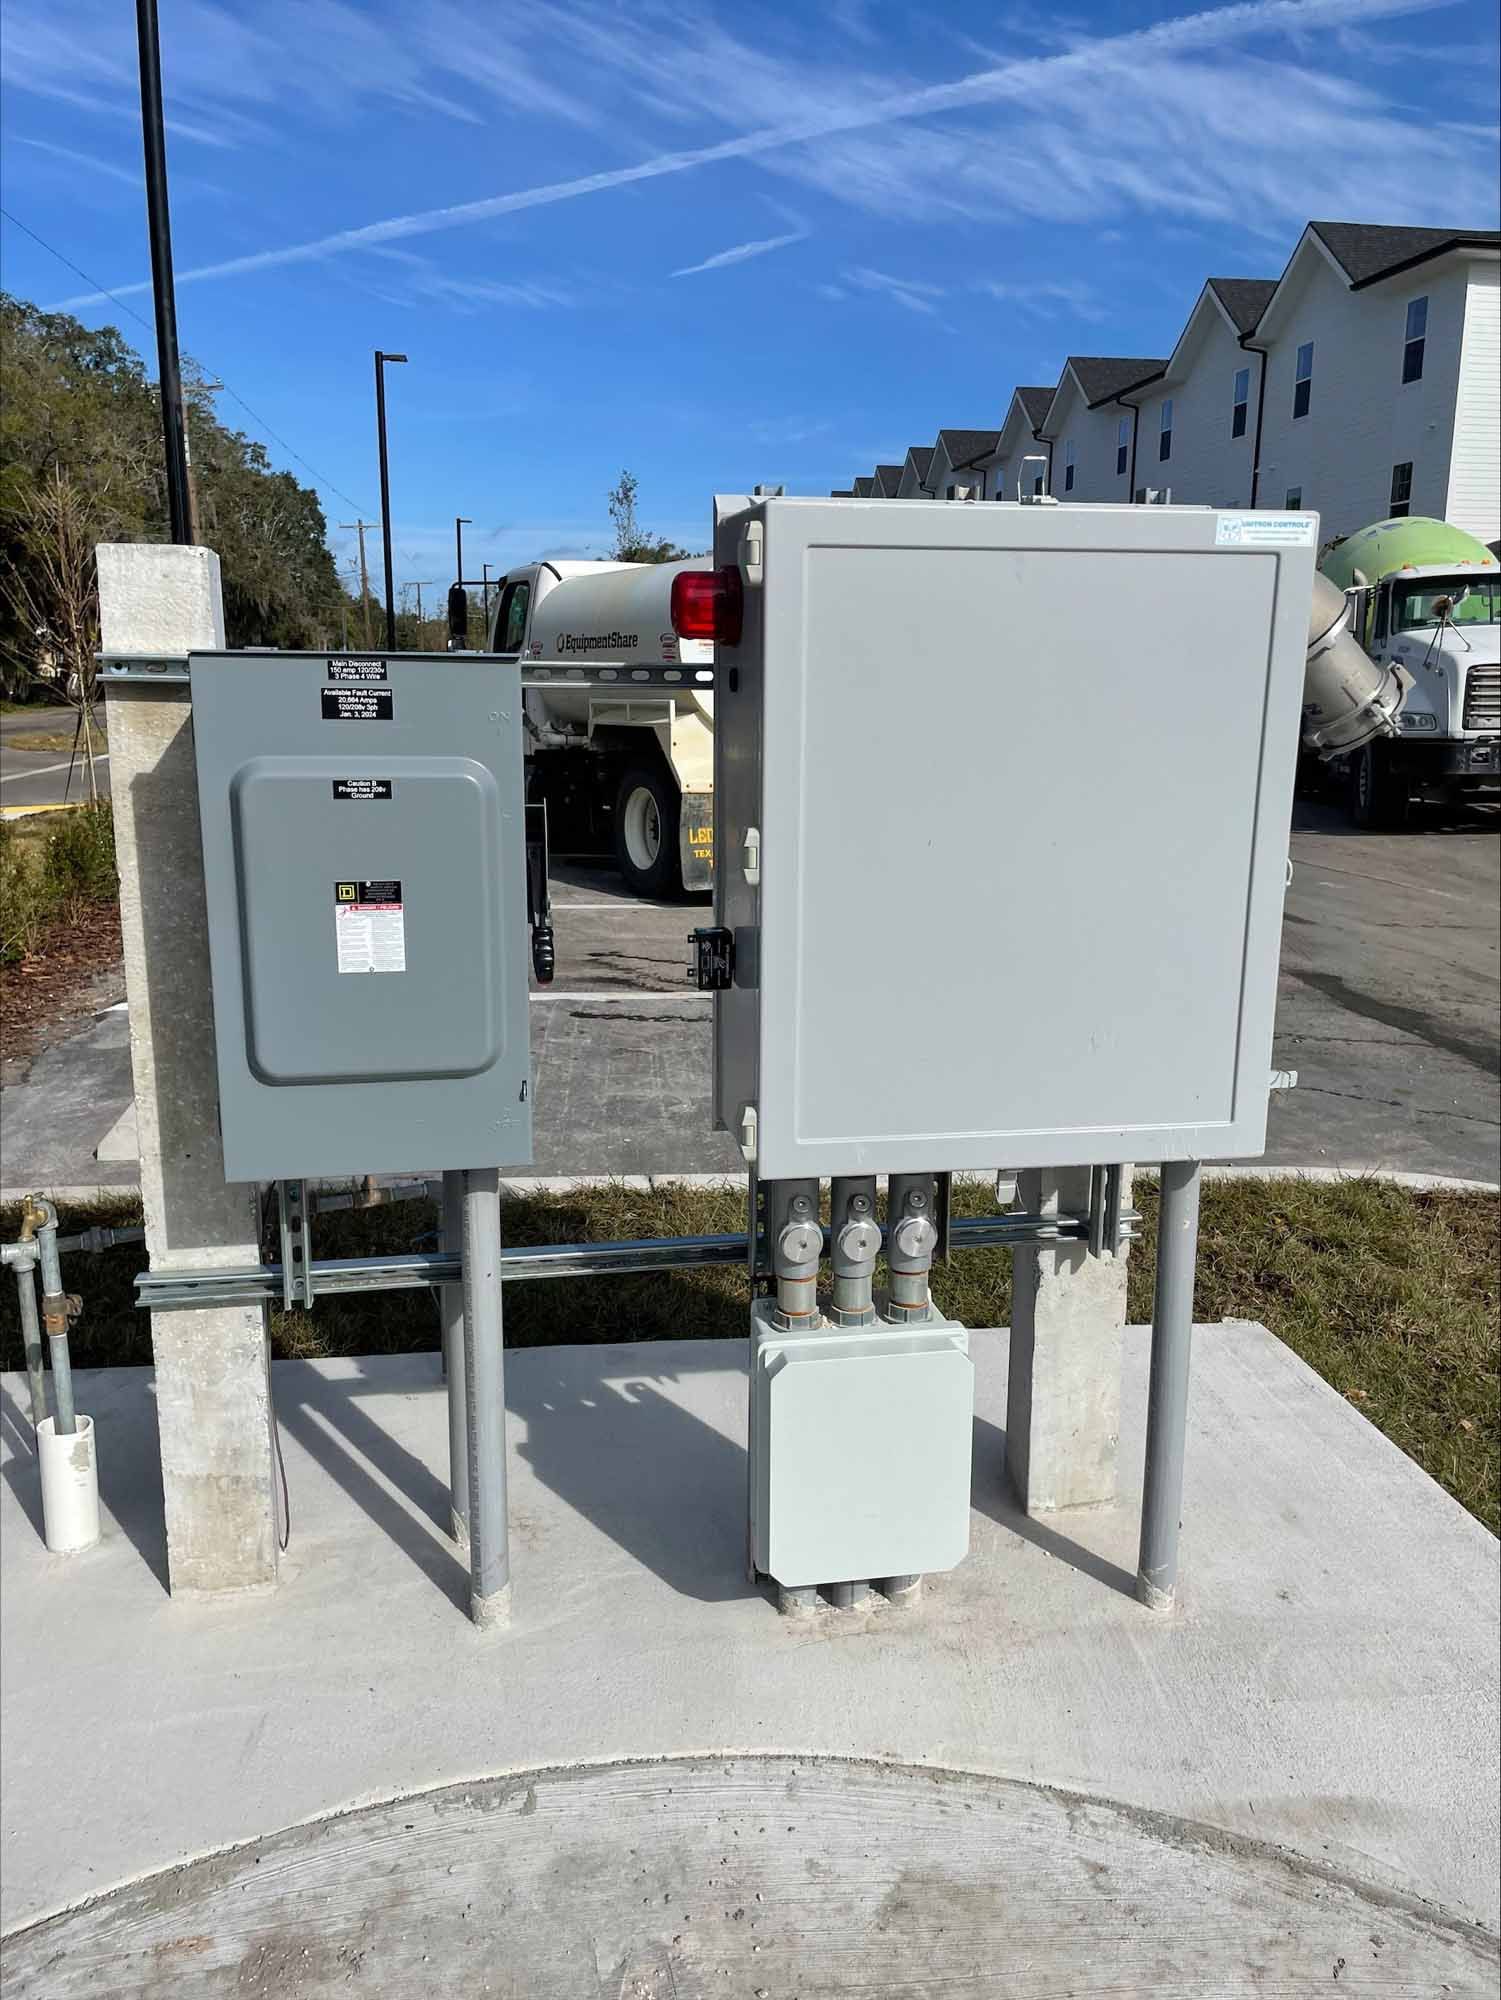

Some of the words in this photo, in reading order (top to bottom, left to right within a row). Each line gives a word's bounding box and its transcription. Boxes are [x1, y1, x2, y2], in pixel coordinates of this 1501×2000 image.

[565, 632, 638, 653] EquipmentShare
[488, 711, 512, 721] ON
[693, 849, 713, 858] TEX
